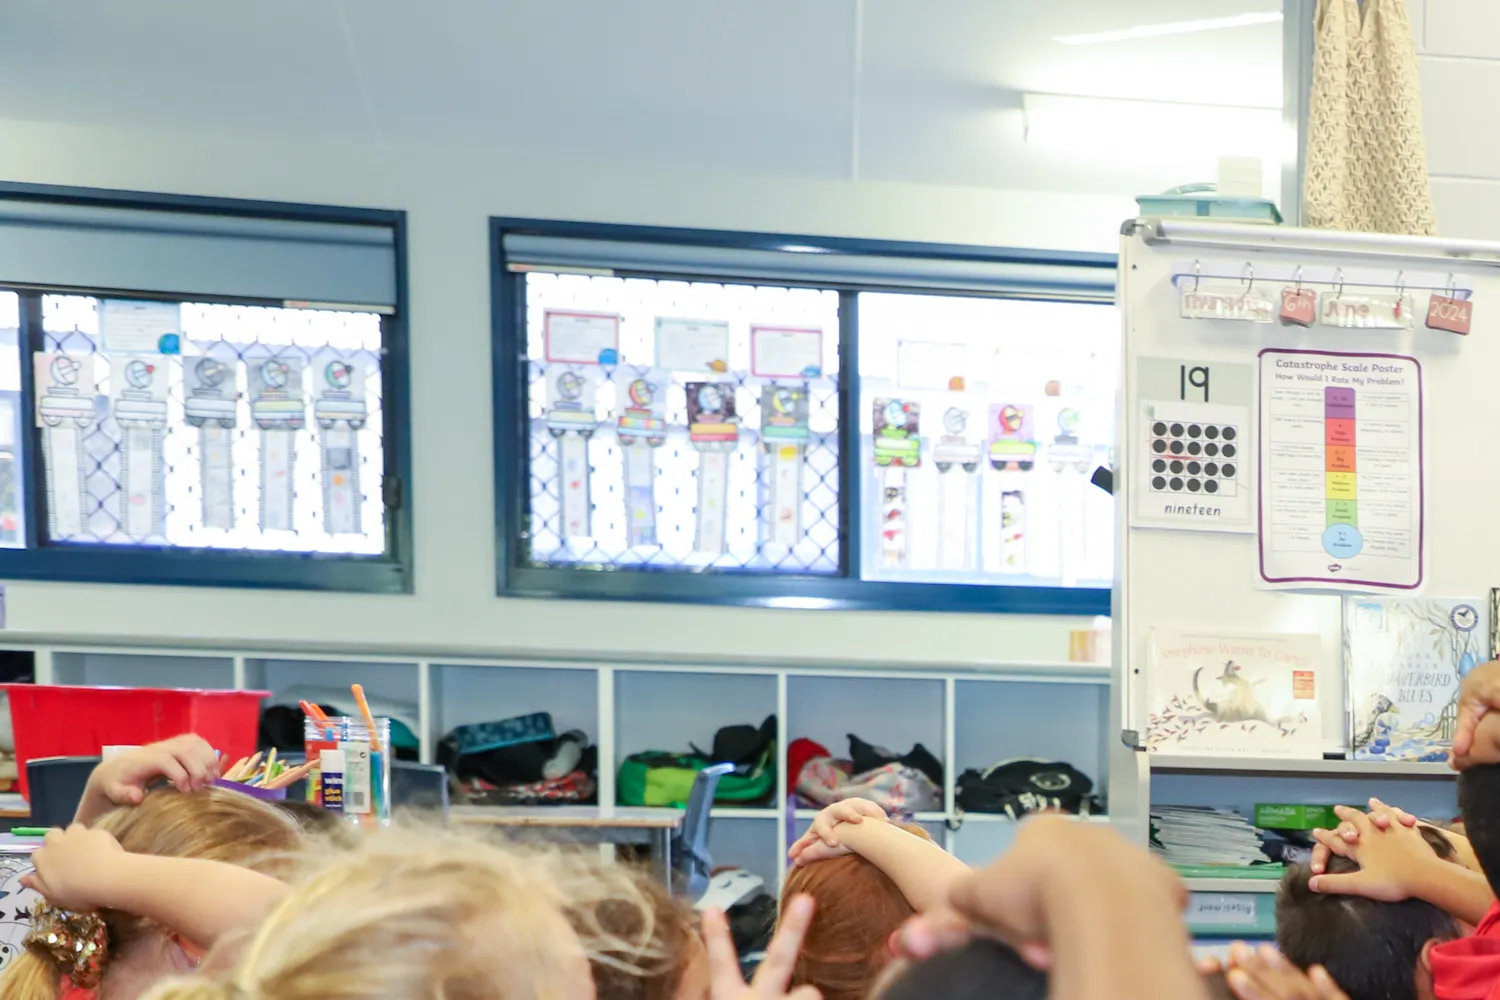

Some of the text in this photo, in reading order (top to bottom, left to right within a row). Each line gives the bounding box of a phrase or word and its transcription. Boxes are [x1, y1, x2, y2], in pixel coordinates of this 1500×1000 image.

[1430, 301, 1469, 323] 2024
[1275, 359, 1403, 374] Catastrophe Scale Poster
[1180, 364, 1210, 403] 19
[1275, 372, 1294, 381] How
[1296, 373, 1323, 383] Would
[1331, 375, 1350, 384] Rate
[1352, 376, 1365, 387] My
[1366, 377, 1405, 387] Problem?
[1164, 502, 1222, 518] nineteen
